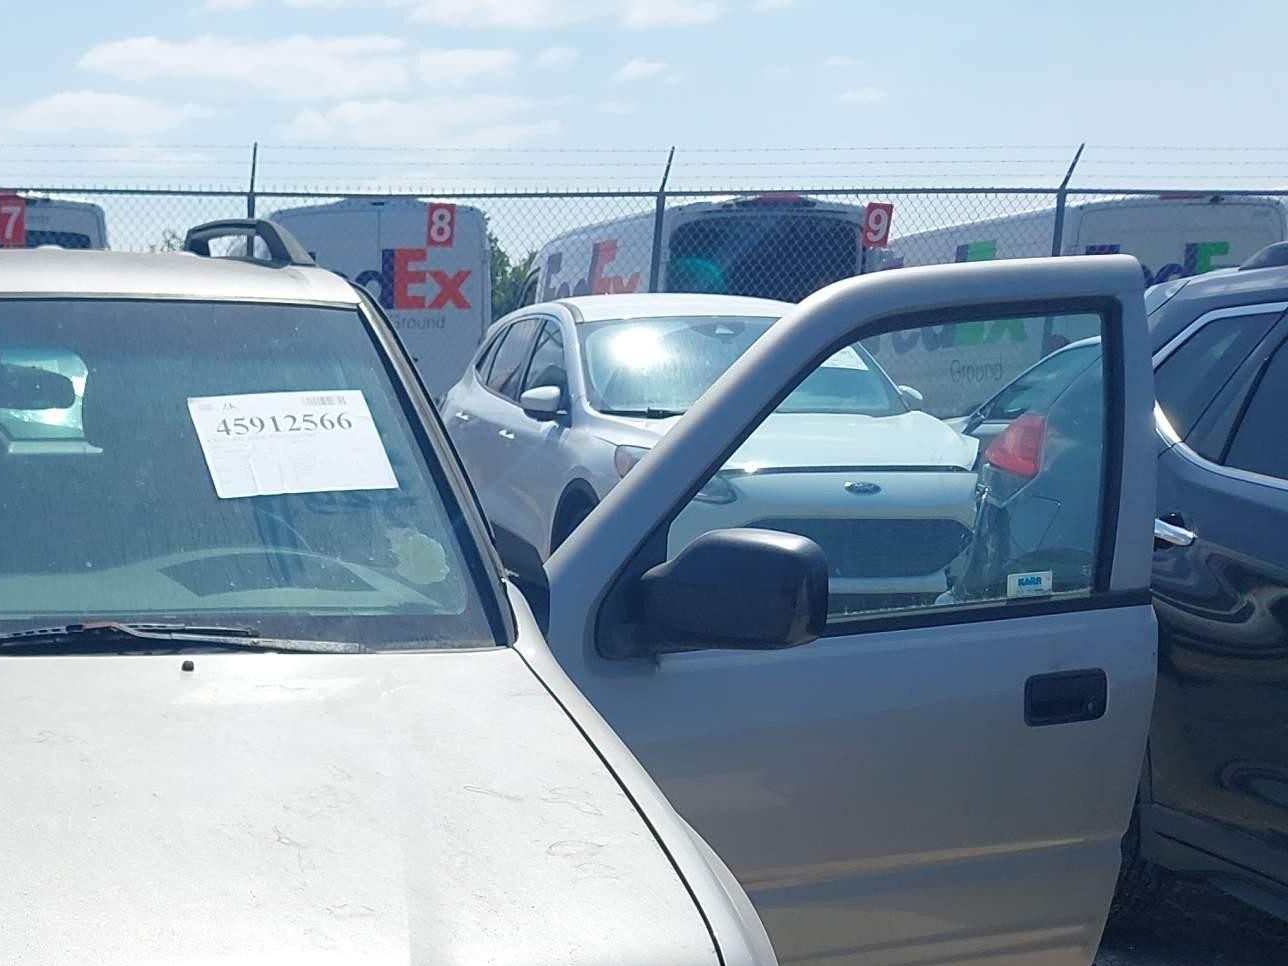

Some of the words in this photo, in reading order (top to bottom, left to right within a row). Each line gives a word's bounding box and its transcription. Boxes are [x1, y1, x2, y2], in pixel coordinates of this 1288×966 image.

[0, 206, 21, 240] 7
[430, 208, 452, 242] 8
[865, 208, 889, 242] 9
[309, 249, 472, 309] dEx
[950, 356, 1003, 384] Ground
[216, 412, 353, 436] 45912566
